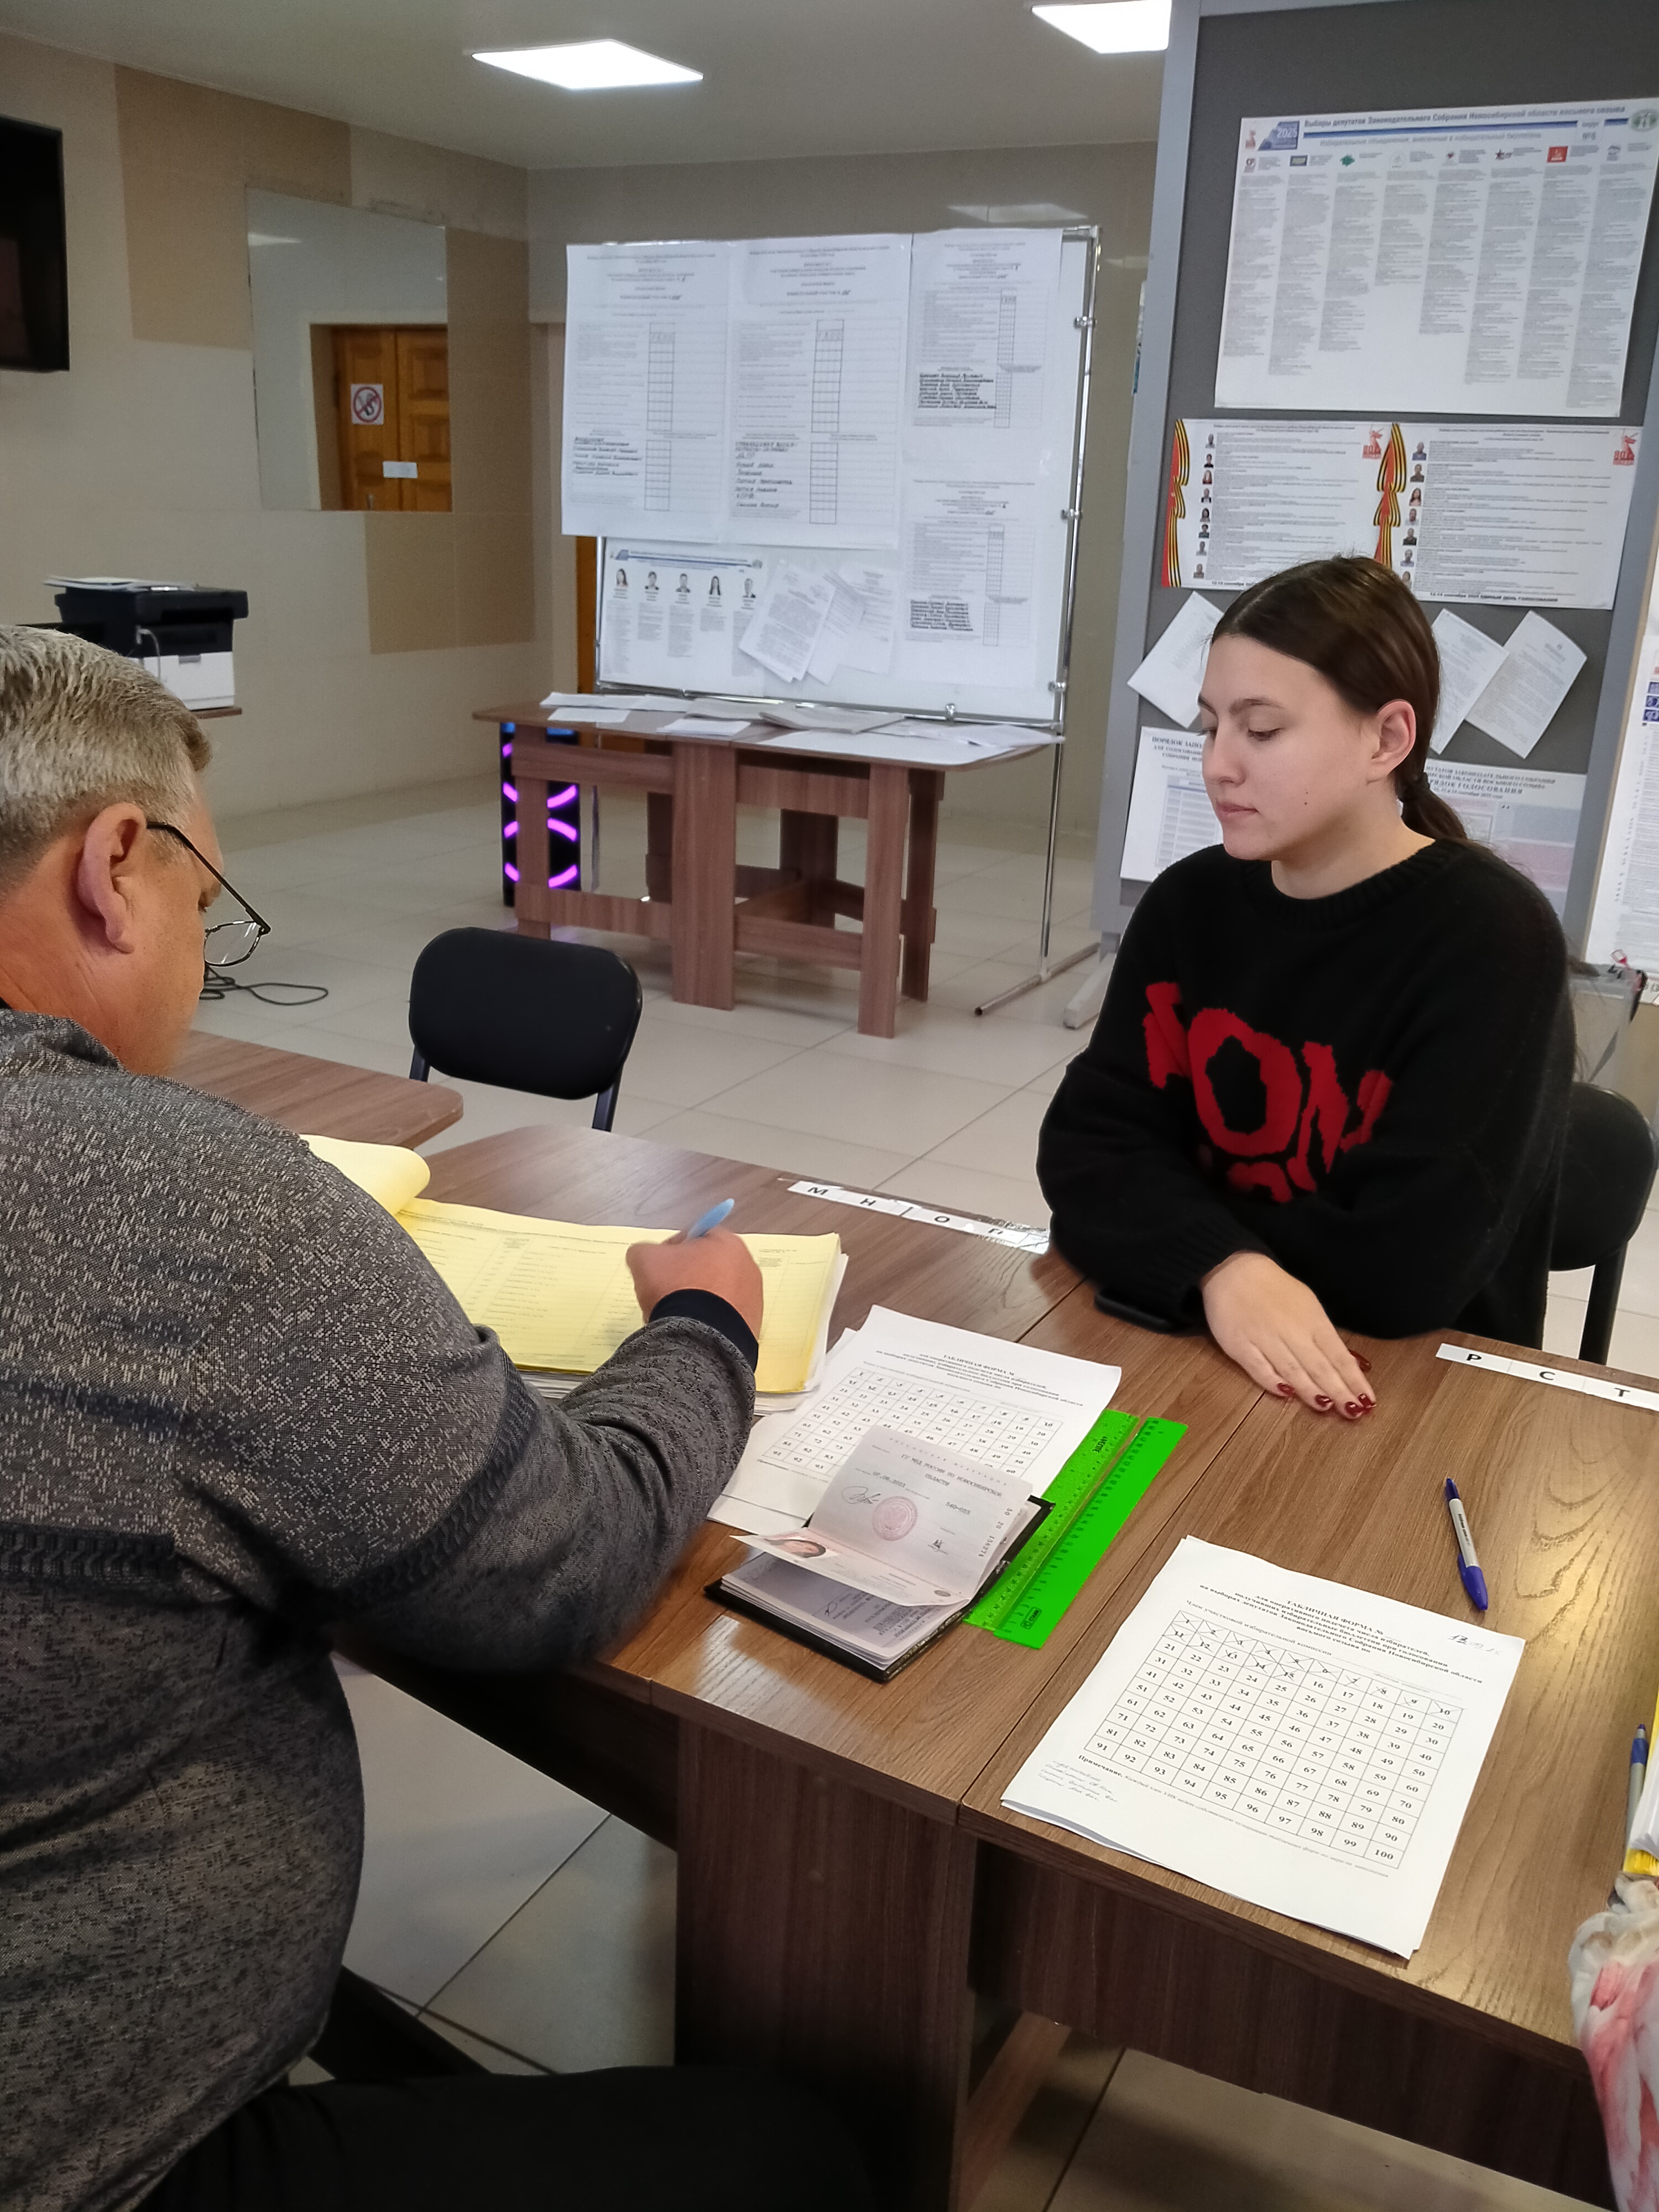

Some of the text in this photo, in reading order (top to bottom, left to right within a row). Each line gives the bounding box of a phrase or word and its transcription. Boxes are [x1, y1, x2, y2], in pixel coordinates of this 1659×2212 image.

[1276, 127, 1298, 139] 2025
[1305, 119, 1331, 128] Выборы
[1333, 118, 1366, 127] депутатов
[1368, 114, 1431, 125] Законодательного
[1432, 113, 1467, 123] Собрания
[1469, 111, 1526, 120] Новосибирской
[807, 1186, 830, 1196] М
[859, 1198, 877, 1207] Н
[1465, 1353, 1631, 1398] Р С Т
[1186, 1599, 1203, 1610] Член
[1203, 1608, 1243, 1626] участковой
[1244, 1624, 1296, 1644] избирательной
[1209, 1588, 1241, 1603] выборах
[1243, 1600, 1278, 1616] депутатов
[1280, 1614, 1347, 1638] Законодательного
[1348, 1636, 1386, 1653] Собрания
[1387, 1650, 1449, 1673] Новосибирской
[1450, 1670, 1483, 1684] области
[1234, 1592, 1448, 1667] получивших избирательные бюллетени при голосовании
[1270, 1600, 1320, 1620] оперативного
[1321, 1617, 1355, 1632] подсчета
[1356, 1629, 1379, 1639] числа
[1380, 1635, 1430, 1657] избирателей,
[1287, 1600, 1339, 1621] ТАБЛИЧНАЯ
[1340, 1616, 1373, 1632] ФОРМА
[1296, 1625, 1331, 1641] восьмого
[1332, 1637, 1360, 1649] созыва
[1182, 1667, 1193, 1676] 32
[1297, 1709, 1308, 1718] 36
[1358, 1731, 1370, 1739] 38
[1162, 1695, 1175, 1703] 52
[1220, 1718, 1233, 1726] 54
[1280, 1740, 1292, 1748] 56
[1342, 1762, 1355, 1771] 58
[1426, 1737, 1438, 1745] 30
[1078, 1754, 1123, 1777] Примечание.
[1118, 1713, 1405, 1825] 71 72 73 74 75 76 77 78 79 80
[1154, 1710, 1166, 1718] 62
[1272, 1755, 1285, 1764] 66
[1400, 1799, 1412, 1809] 70
[1411, 1768, 1425, 1777] 50
[1097, 1743, 1394, 1860] 91 92 93 94 95 96 97 98 99 100
[1106, 1728, 1397, 1841] 81 82 83 84 85 86 87 88 89 90
